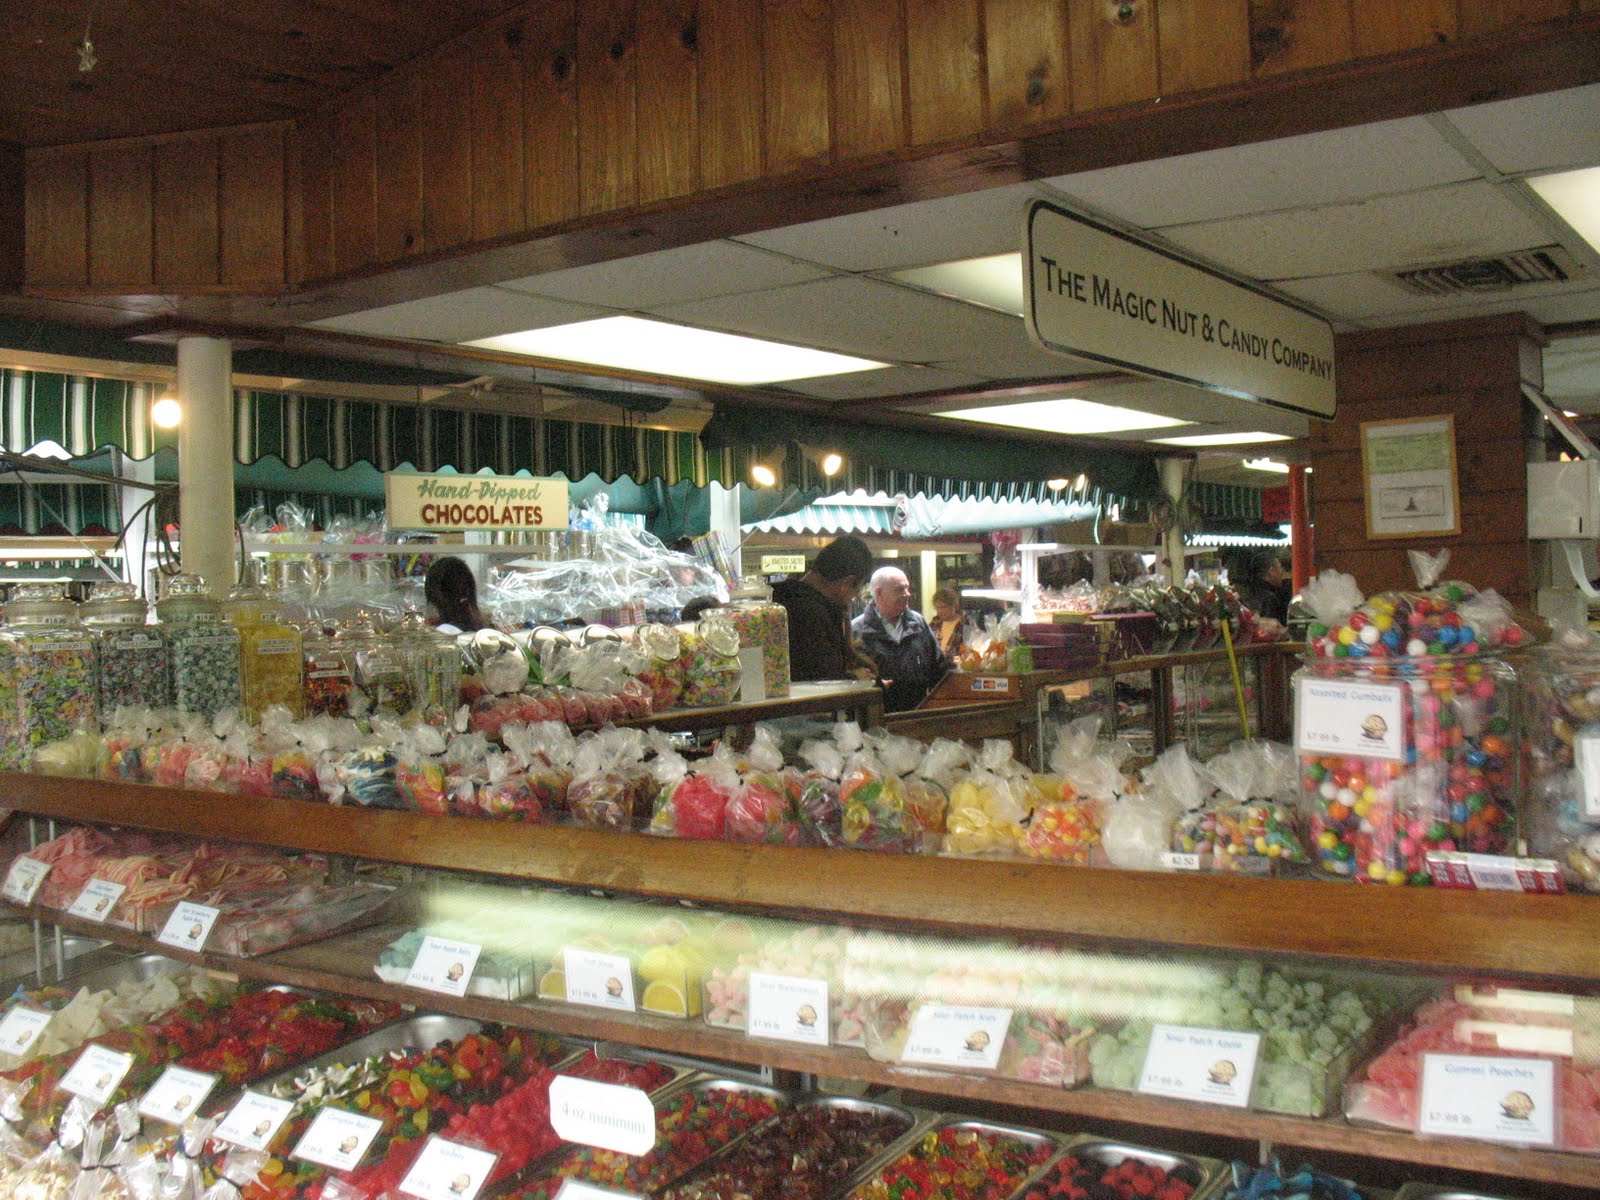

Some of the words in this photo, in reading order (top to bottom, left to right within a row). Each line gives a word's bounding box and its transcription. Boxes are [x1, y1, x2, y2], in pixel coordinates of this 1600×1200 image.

[1041, 256, 1087, 302] THE
[1093, 274, 1157, 325] MAGIC
[1162, 299, 1198, 338] NUT
[1202, 313, 1214, 342] &
[1218, 319, 1268, 361] CANDY
[1272, 338, 1333, 381] COMPANY
[417, 479, 542, 505] Hand-Dipped
[421, 503, 543, 526] CHOCOLATES
